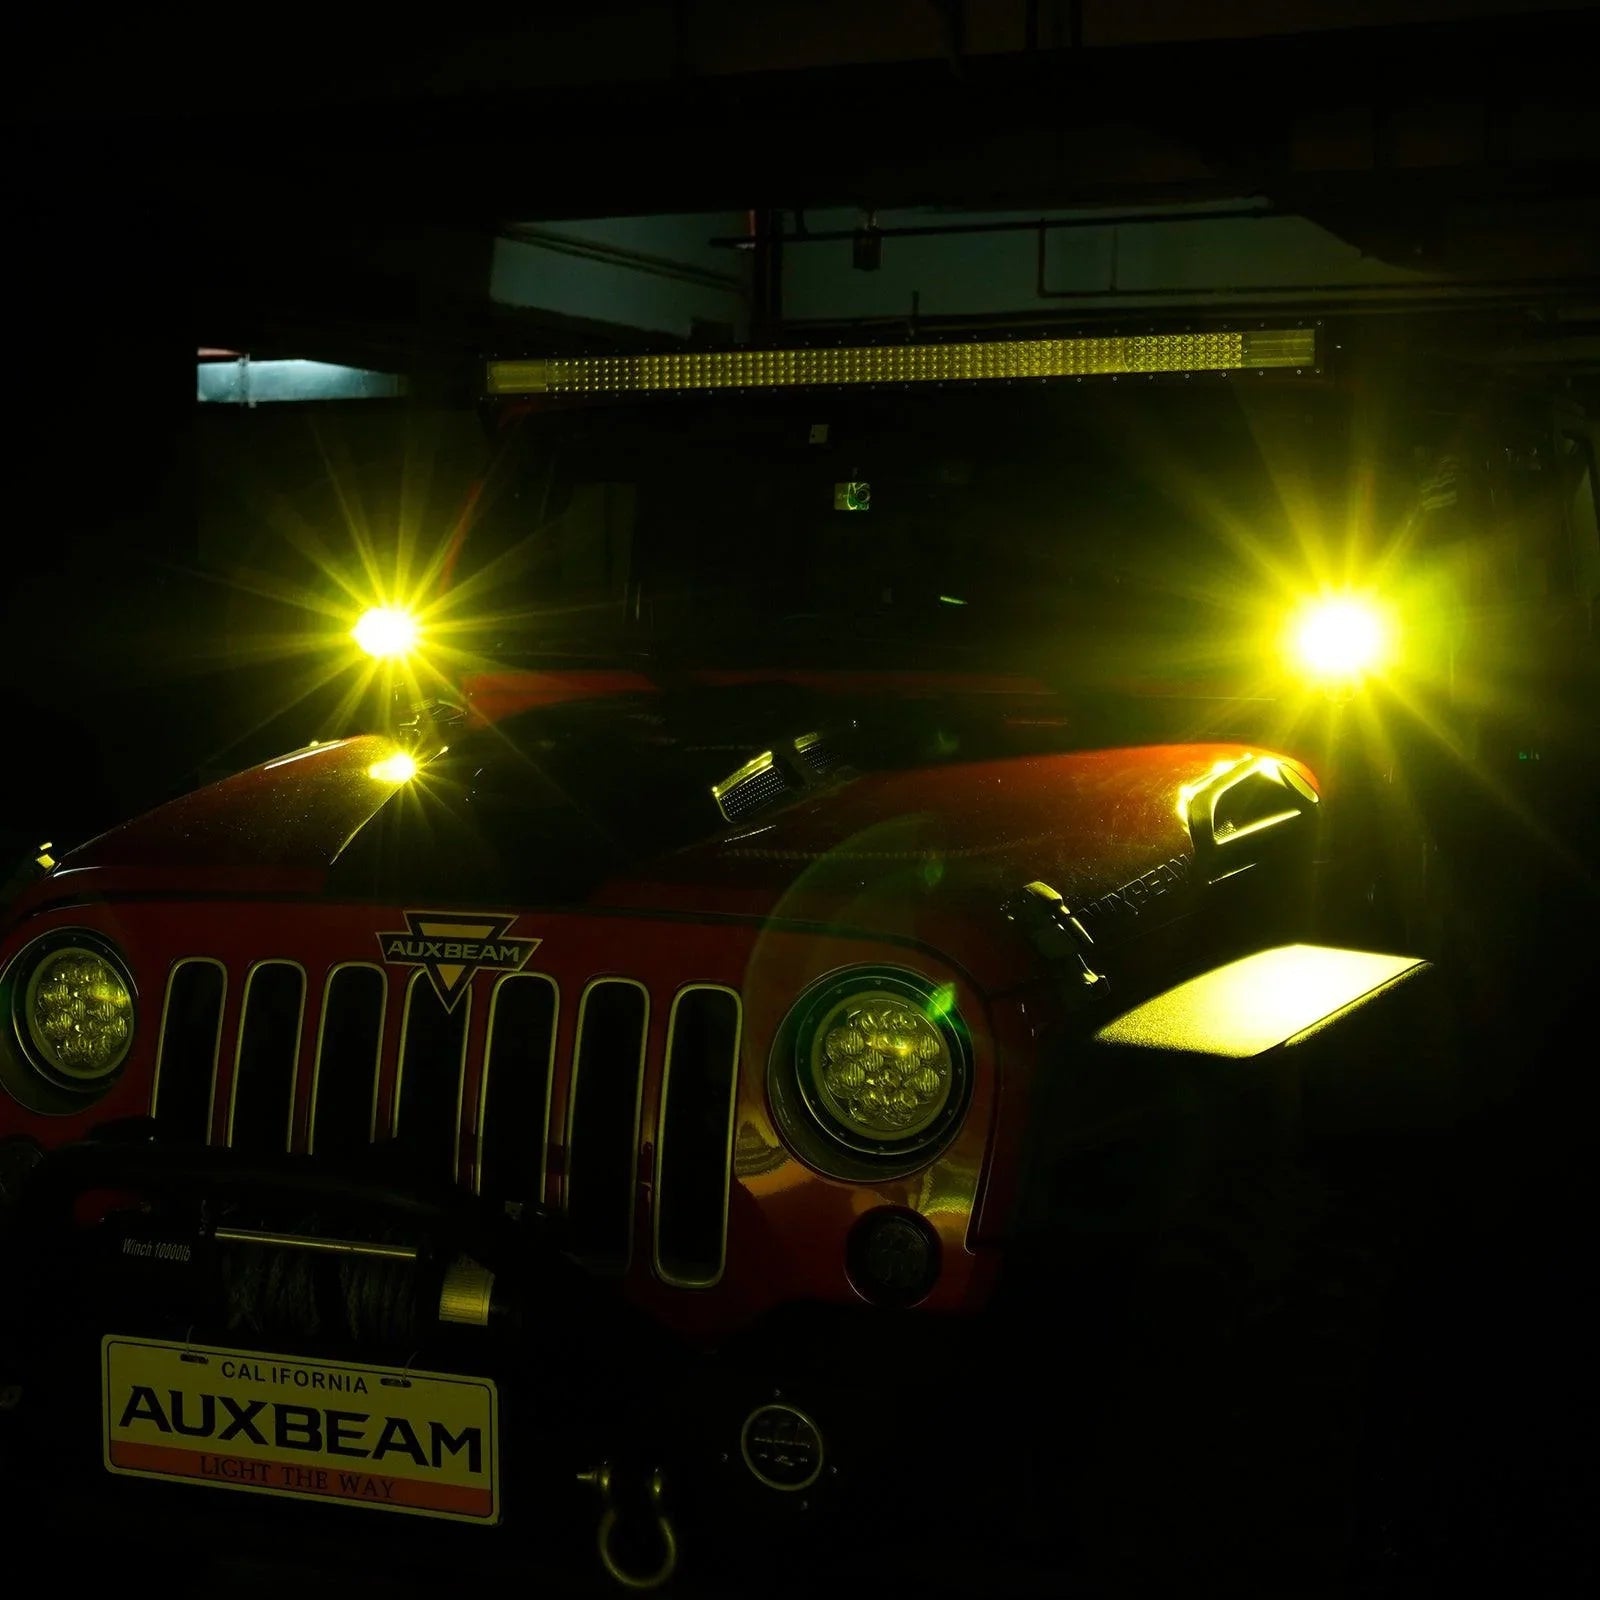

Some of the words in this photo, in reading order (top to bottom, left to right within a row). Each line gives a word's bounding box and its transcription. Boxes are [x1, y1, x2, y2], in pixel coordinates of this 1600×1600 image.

[387, 940, 520, 962] AUXBEAM
[122, 1238, 153, 1257] Winch
[221, 1361, 368, 1394] CALIFORNIA
[118, 1385, 483, 1474] AUXBEAM
[199, 1455, 271, 1482] LIGHT
[281, 1466, 328, 1490] THE
[338, 1473, 396, 1499] WAY
